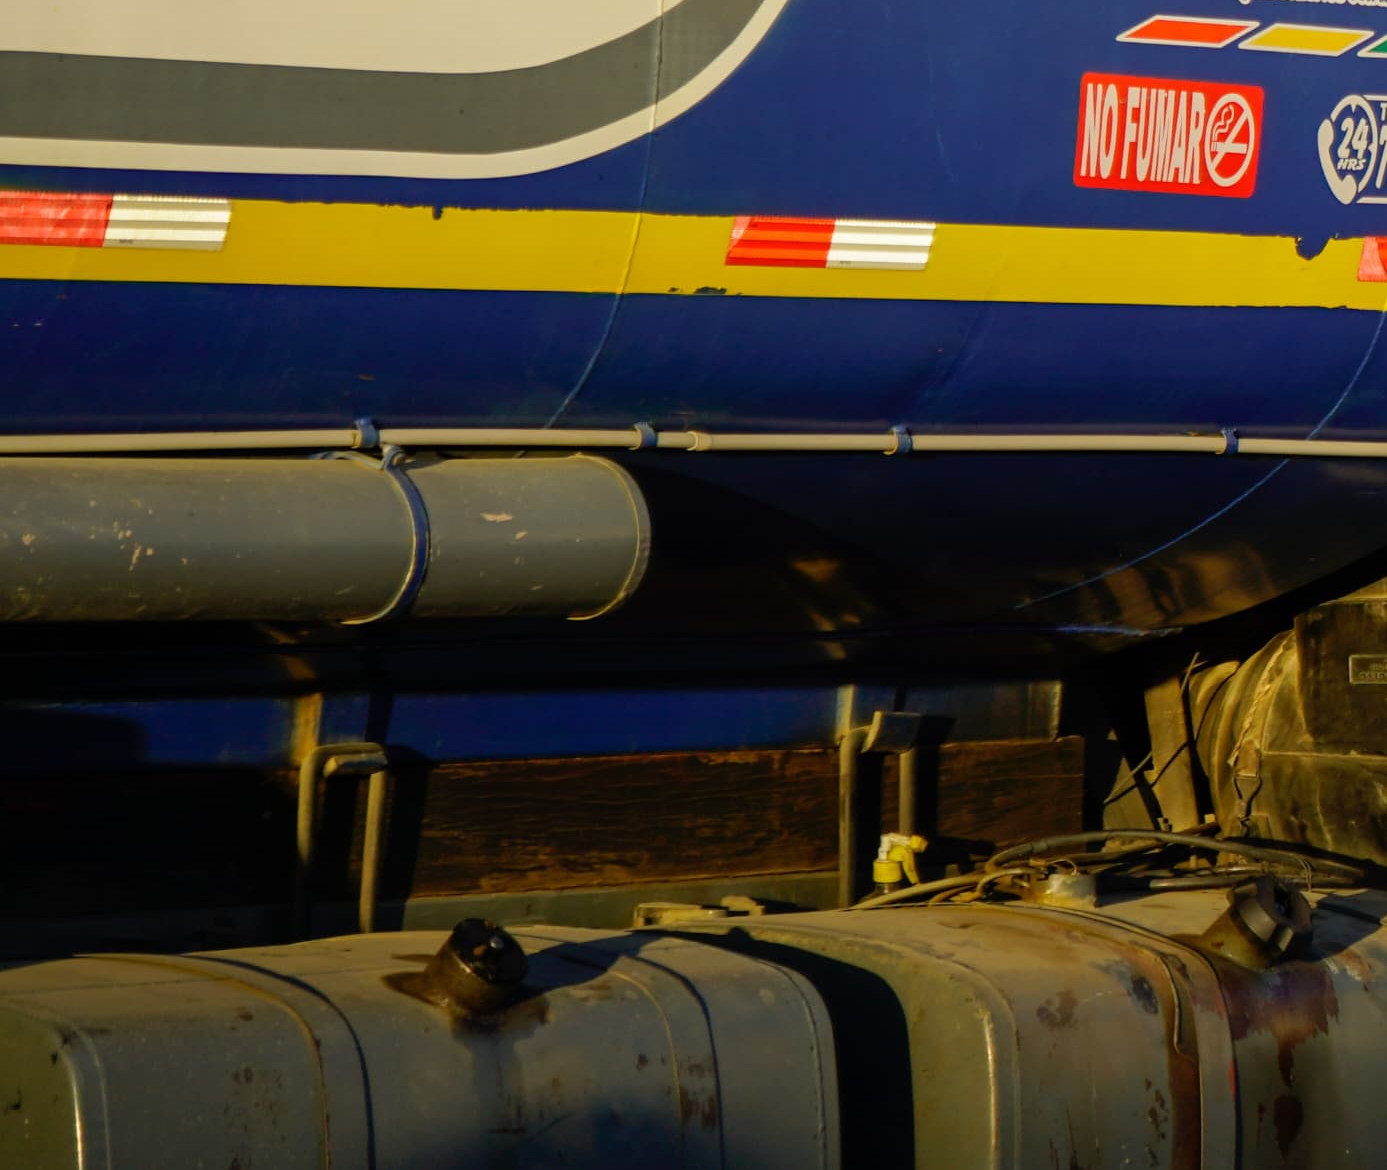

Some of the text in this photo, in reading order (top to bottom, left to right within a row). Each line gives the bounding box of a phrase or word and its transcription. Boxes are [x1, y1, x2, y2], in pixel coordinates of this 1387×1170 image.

[1080, 83, 1206, 185] NO FUMAR
[1337, 117, 1370, 160] 24
[1336, 158, 1367, 171] HRS
